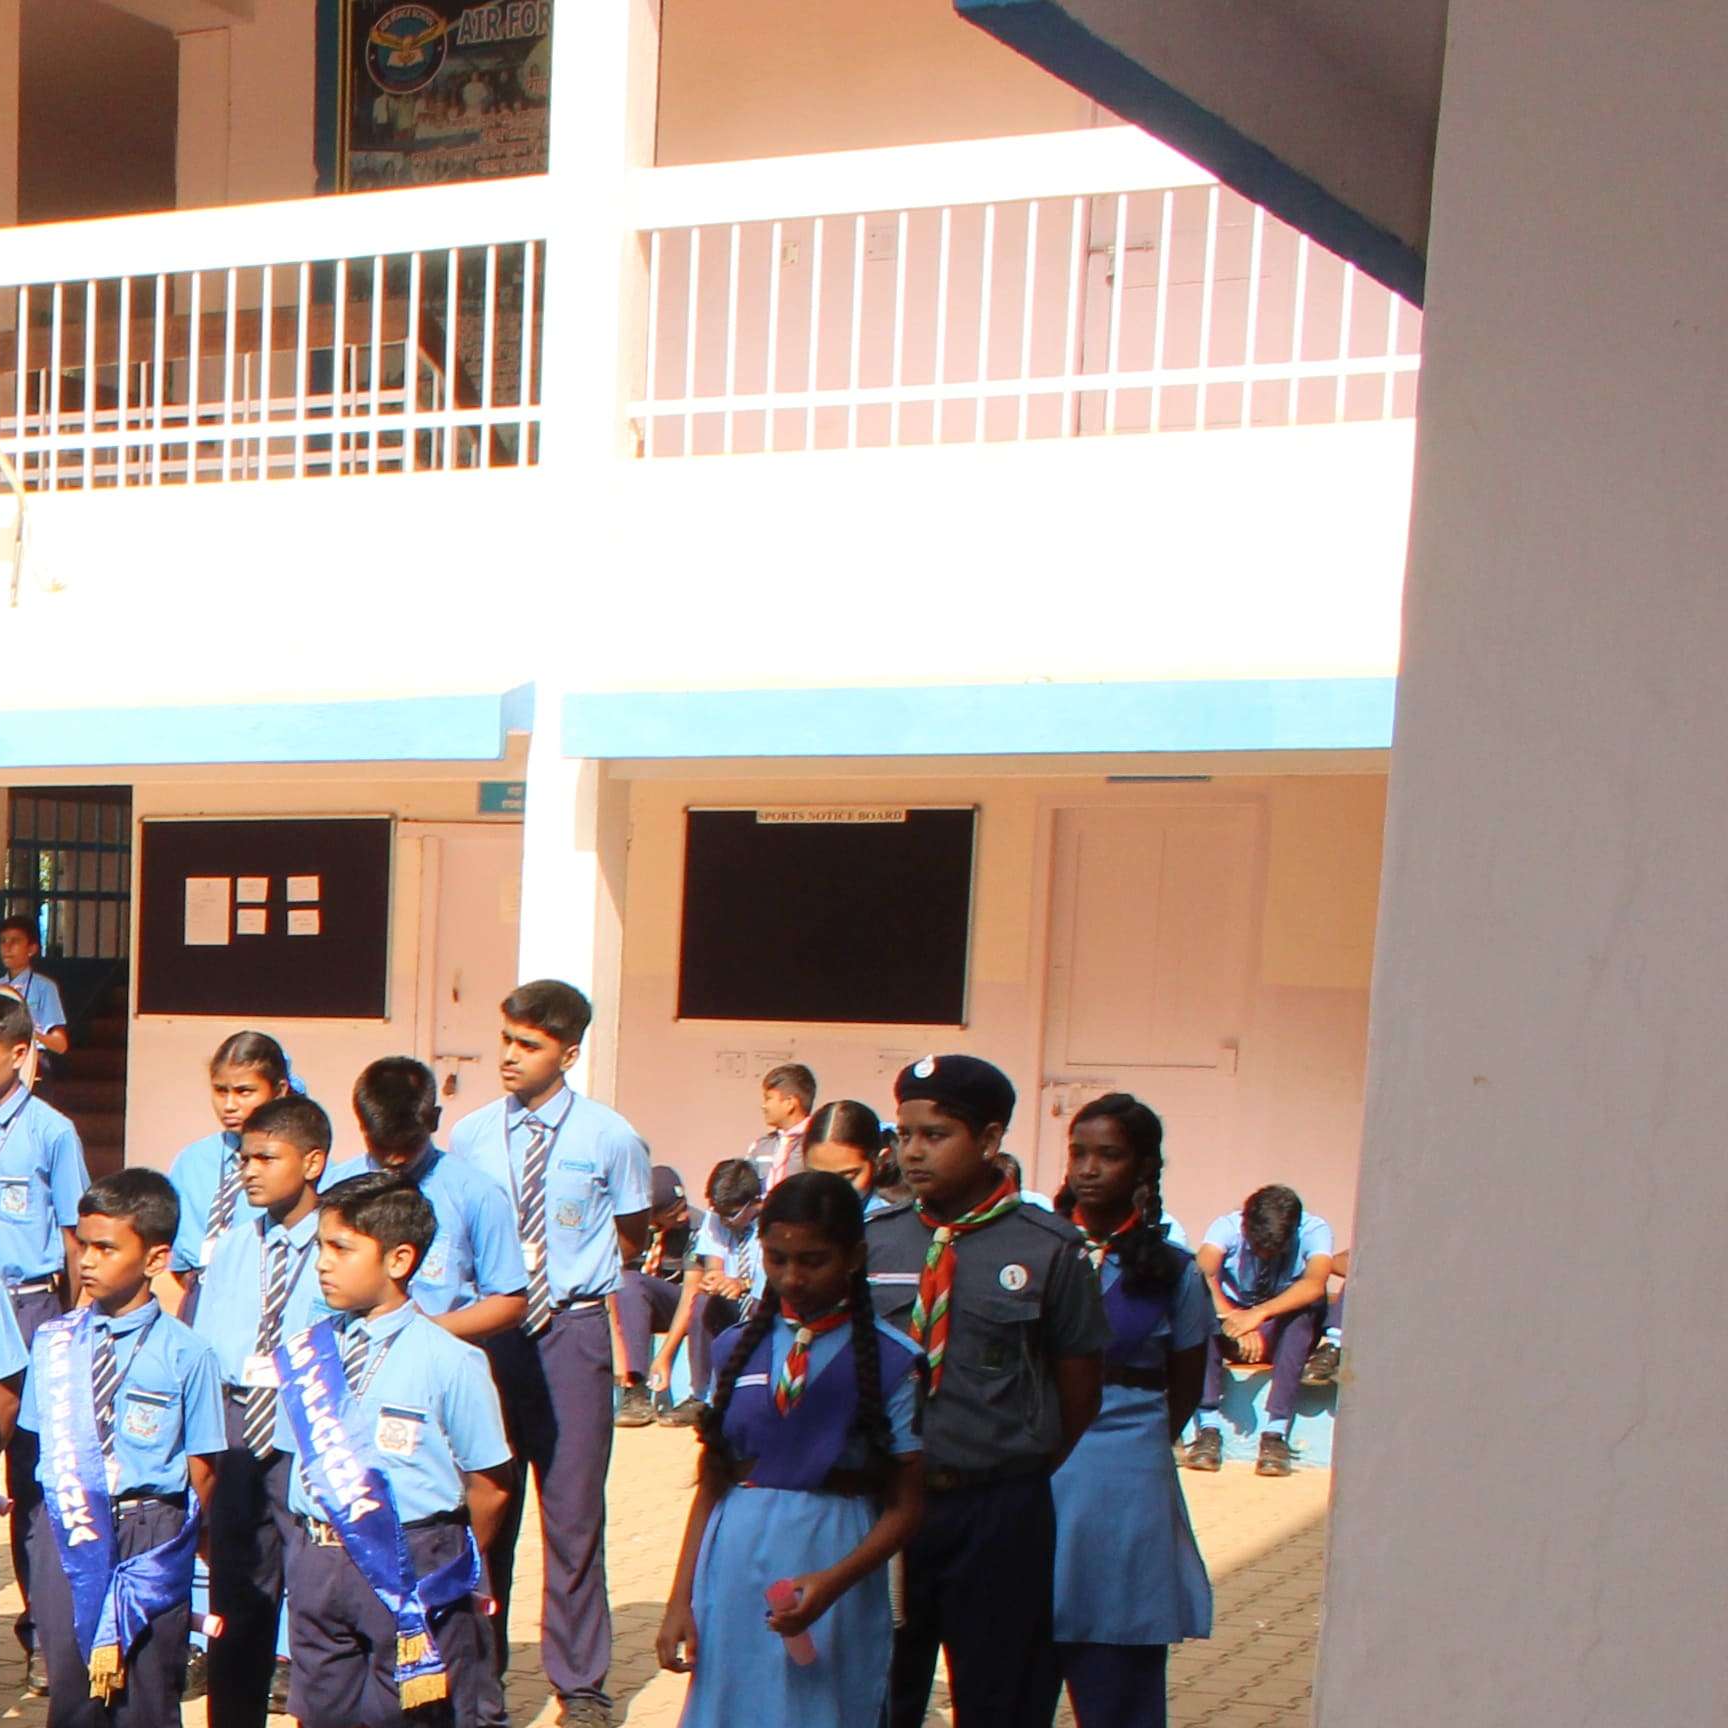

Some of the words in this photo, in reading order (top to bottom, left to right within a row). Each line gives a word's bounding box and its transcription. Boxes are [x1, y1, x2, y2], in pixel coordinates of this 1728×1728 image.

[457, 7, 502, 45] AIR
[759, 811, 804, 821] SPORTS
[811, 811, 852, 821] NOTICE
[858, 810, 902, 820] BOARD
[286, 1327, 317, 1371] FS
[49, 1383, 100, 1547] YELAHANKA
[294, 1363, 382, 1523] YELAHANKA
